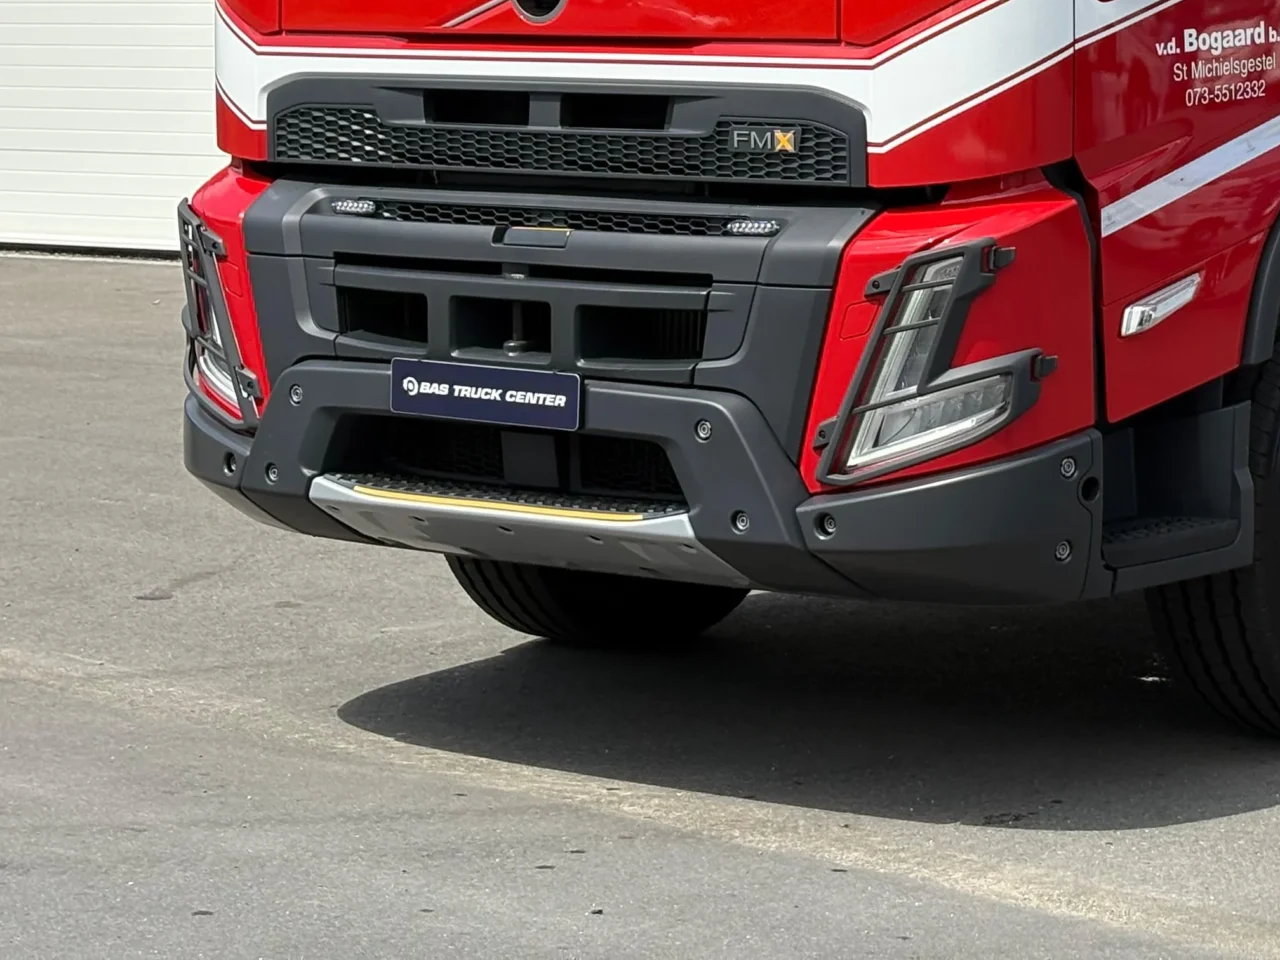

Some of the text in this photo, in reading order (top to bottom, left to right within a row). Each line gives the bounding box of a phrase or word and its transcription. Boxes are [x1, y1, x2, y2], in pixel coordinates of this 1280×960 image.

[1155, 37, 1180, 56] v.d.
[1183, 20, 1265, 55] Bogaard
[1173, 52, 1276, 81] St Michielsgestel
[1185, 79, 1266, 106] 073-5512332
[733, 129, 797, 153] FMX
[419, 381, 566, 407] BAS TRUCK CENTER
